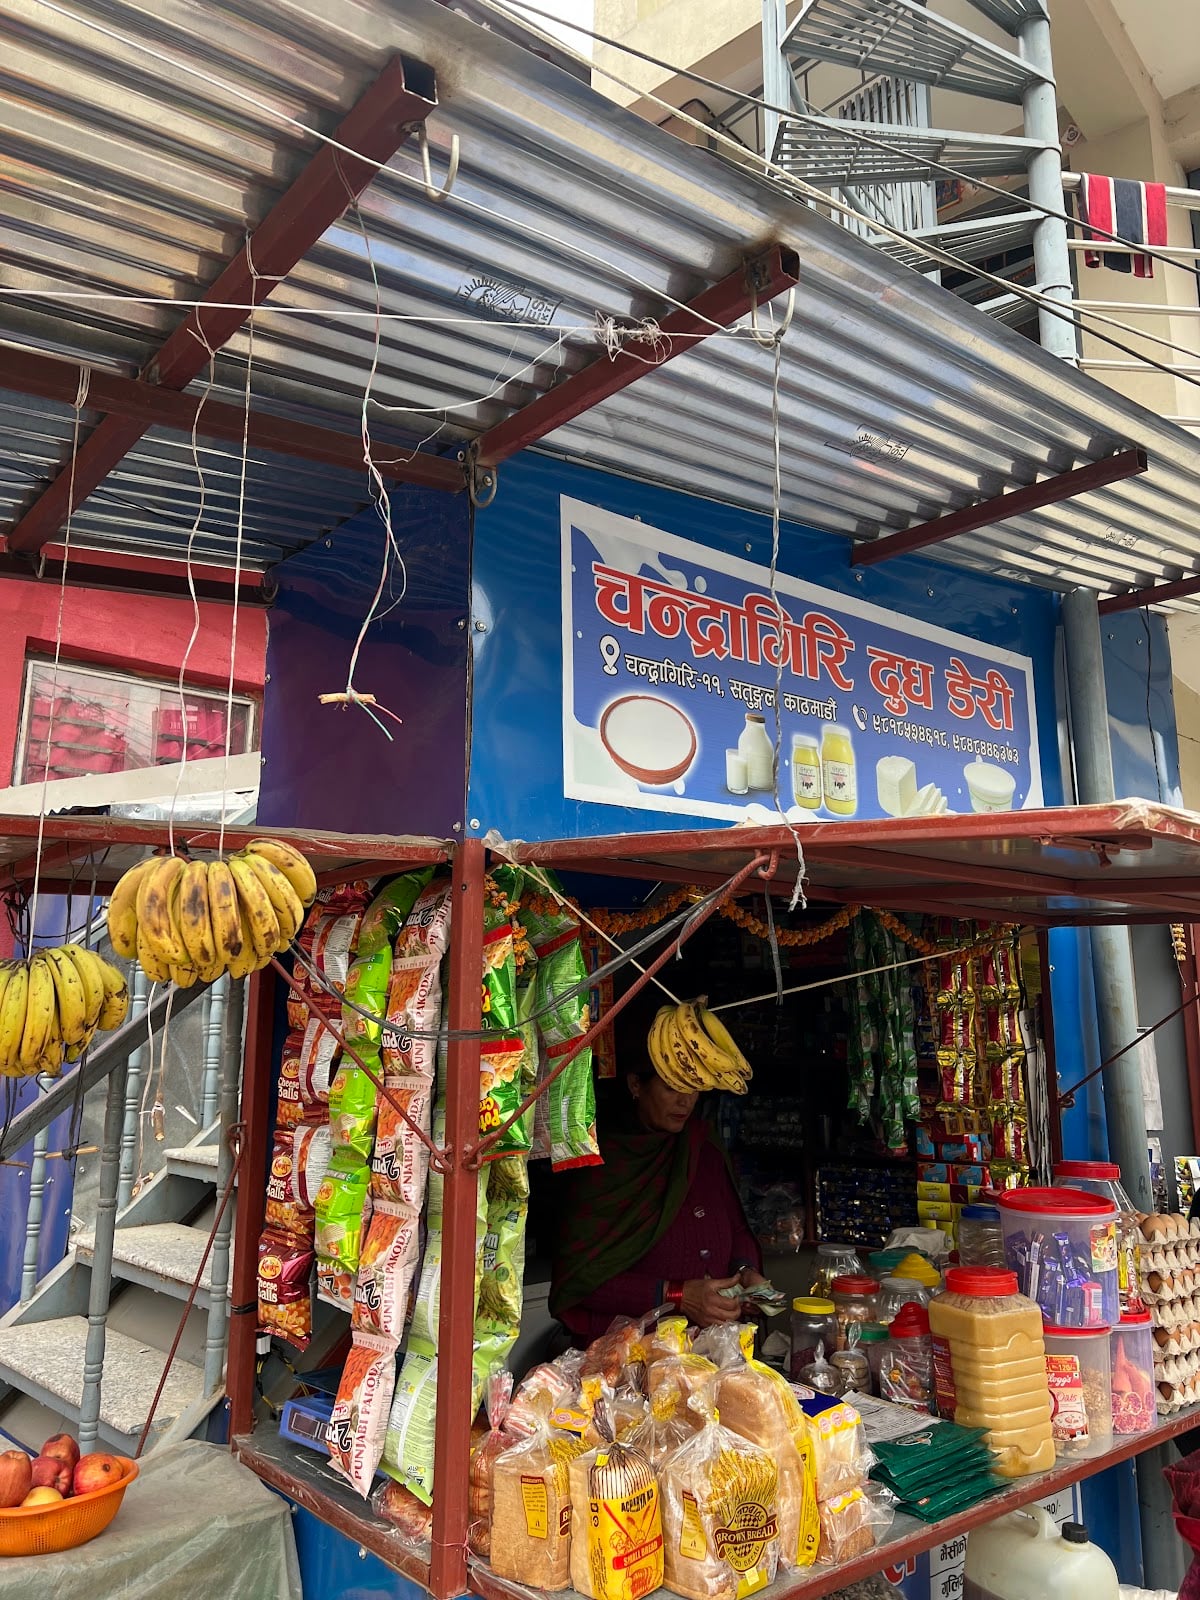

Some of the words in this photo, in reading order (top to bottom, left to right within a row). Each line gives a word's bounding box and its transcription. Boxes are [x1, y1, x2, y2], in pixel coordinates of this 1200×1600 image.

[592, 560, 855, 692] चन्द्रागिरि
[866, 645, 934, 717] दुध
[944, 656, 1015, 731] डेरी
[414, 1020, 426, 1073] PUNJBI
[404, 1097, 421, 1146] PAODA
[402, 1152, 415, 1203] PUNJABI
[384, 1227, 411, 1275] PAKODA
[382, 1275, 395, 1333] PUNJABI
[360, 1360, 383, 1415] PAKODA
[354, 1419, 370, 1480] PUNJABI
[747, 1524, 775, 1540] BREAD
